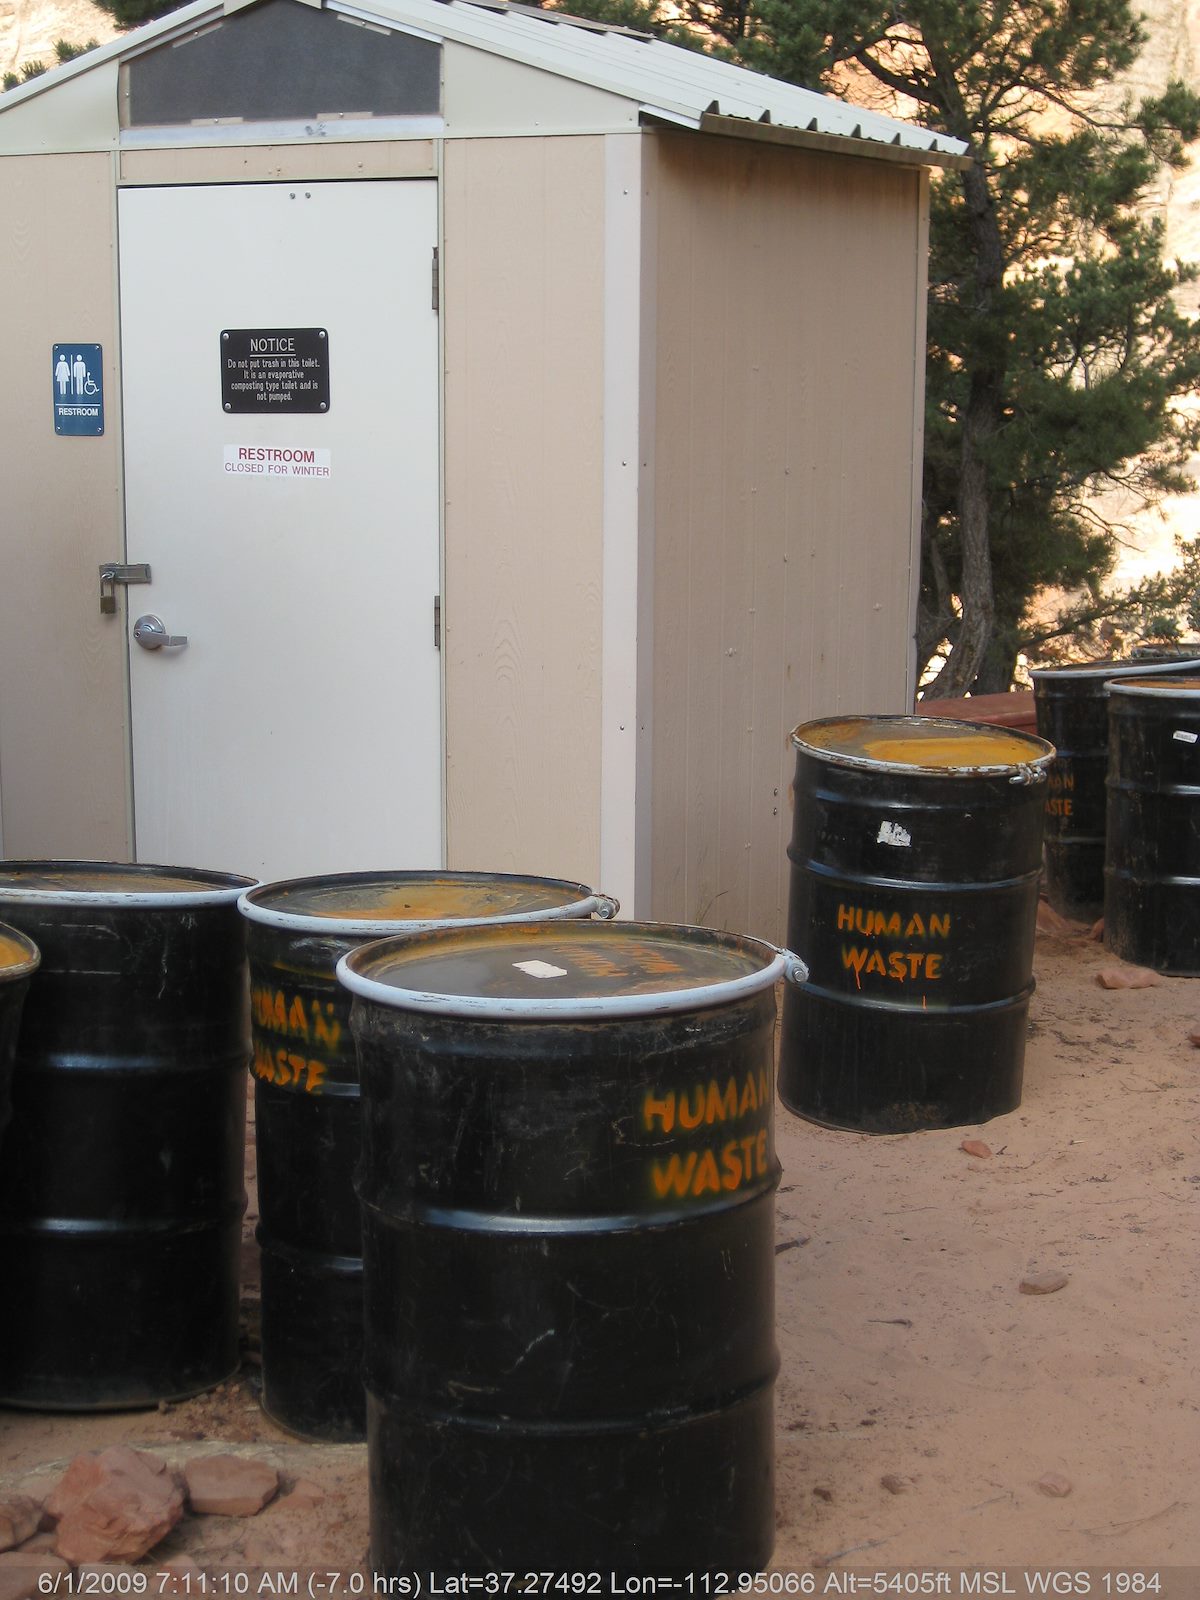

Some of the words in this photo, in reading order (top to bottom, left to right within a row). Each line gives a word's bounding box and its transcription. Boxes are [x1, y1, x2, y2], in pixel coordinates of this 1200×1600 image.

[250, 338, 295, 352] NOTICE
[227, 359, 236, 368] Do
[237, 359, 248, 368] not
[249, 359, 260, 370] put
[262, 359, 279, 368] trash
[280, 359, 287, 368] in
[288, 358, 300, 368] this
[301, 358, 320, 367] toilet.
[243, 370, 249, 379] It
[250, 370, 257, 379] is
[258, 371, 267, 379] an
[267, 369, 304, 380] evaporative
[231, 381, 264, 392] composting
[265, 381, 279, 392] type
[281, 380, 298, 390] toilet
[299, 380, 312, 390] and
[312, 380, 319, 390] is
[256, 391, 267, 401] not
[268, 391, 293, 403] pumped.
[58, 408, 98, 416] RESTROOM
[238, 447, 315, 463] RESTROOM
[224, 462, 264, 473] CLOSED
[268, 464, 288, 474] FOR
[292, 465, 330, 476] WINTER
[1045, 798, 1073, 817] ASTE
[837, 903, 951, 939] HUMAN
[842, 944, 944, 983] WASTE
[643, 1069, 770, 1133] HUMAN
[651, 1128, 768, 1198] WASTE
